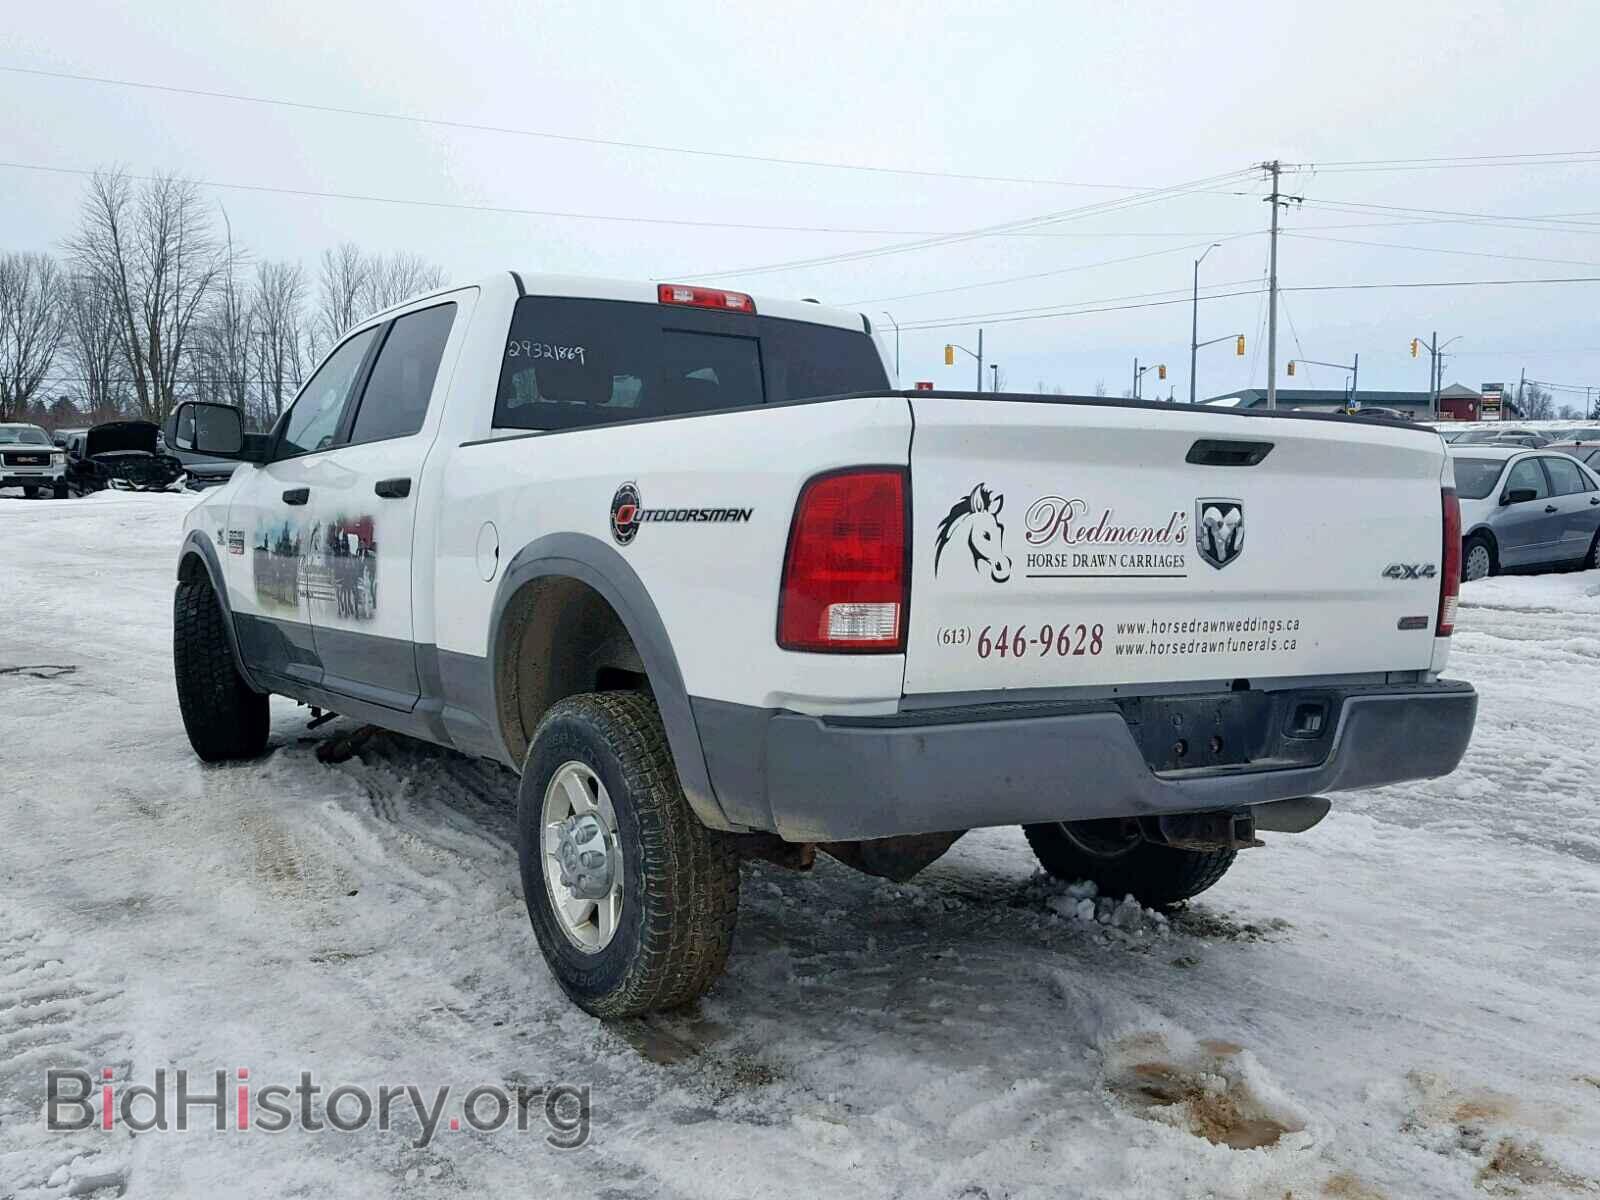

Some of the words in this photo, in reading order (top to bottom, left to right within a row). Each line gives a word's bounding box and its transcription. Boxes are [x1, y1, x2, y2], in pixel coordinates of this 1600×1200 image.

[508, 340, 585, 366] 29321869
[615, 504, 754, 525] OUTDOORSMAN
[1024, 495, 1187, 545] Redmond's
[1026, 553, 1068, 568] HORSE
[1072, 553, 1117, 568] DRAWN
[1120, 553, 1185, 568] CARRIAGES
[1116, 617, 1300, 634] www.horsedrawnweddings.ca
[936, 626, 972, 647] (613)
[977, 623, 1104, 659] 646-9628
[1114, 637, 1297, 655] www.horsedrawnfunerals.ca
